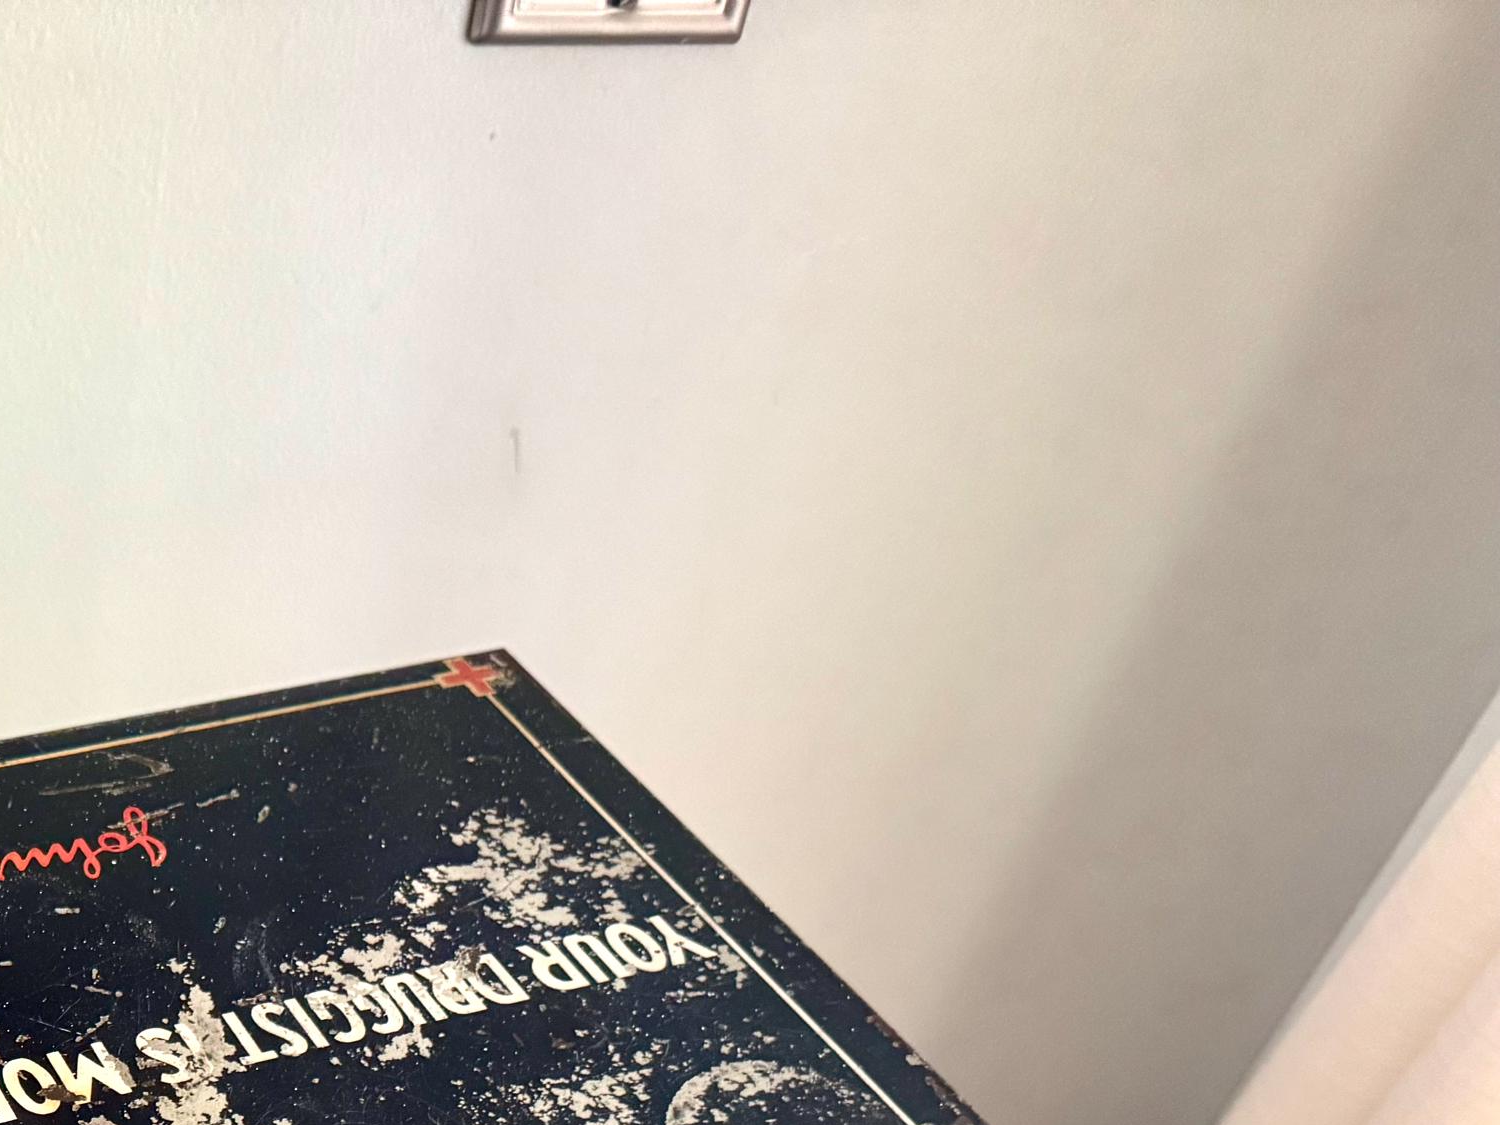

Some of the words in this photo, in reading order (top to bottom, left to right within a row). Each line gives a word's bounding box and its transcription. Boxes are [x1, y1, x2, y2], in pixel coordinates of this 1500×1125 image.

[515, 914, 718, 991] YOUR
[221, 952, 531, 1067] DRUGGIST
[135, 1022, 213, 1085] IS
